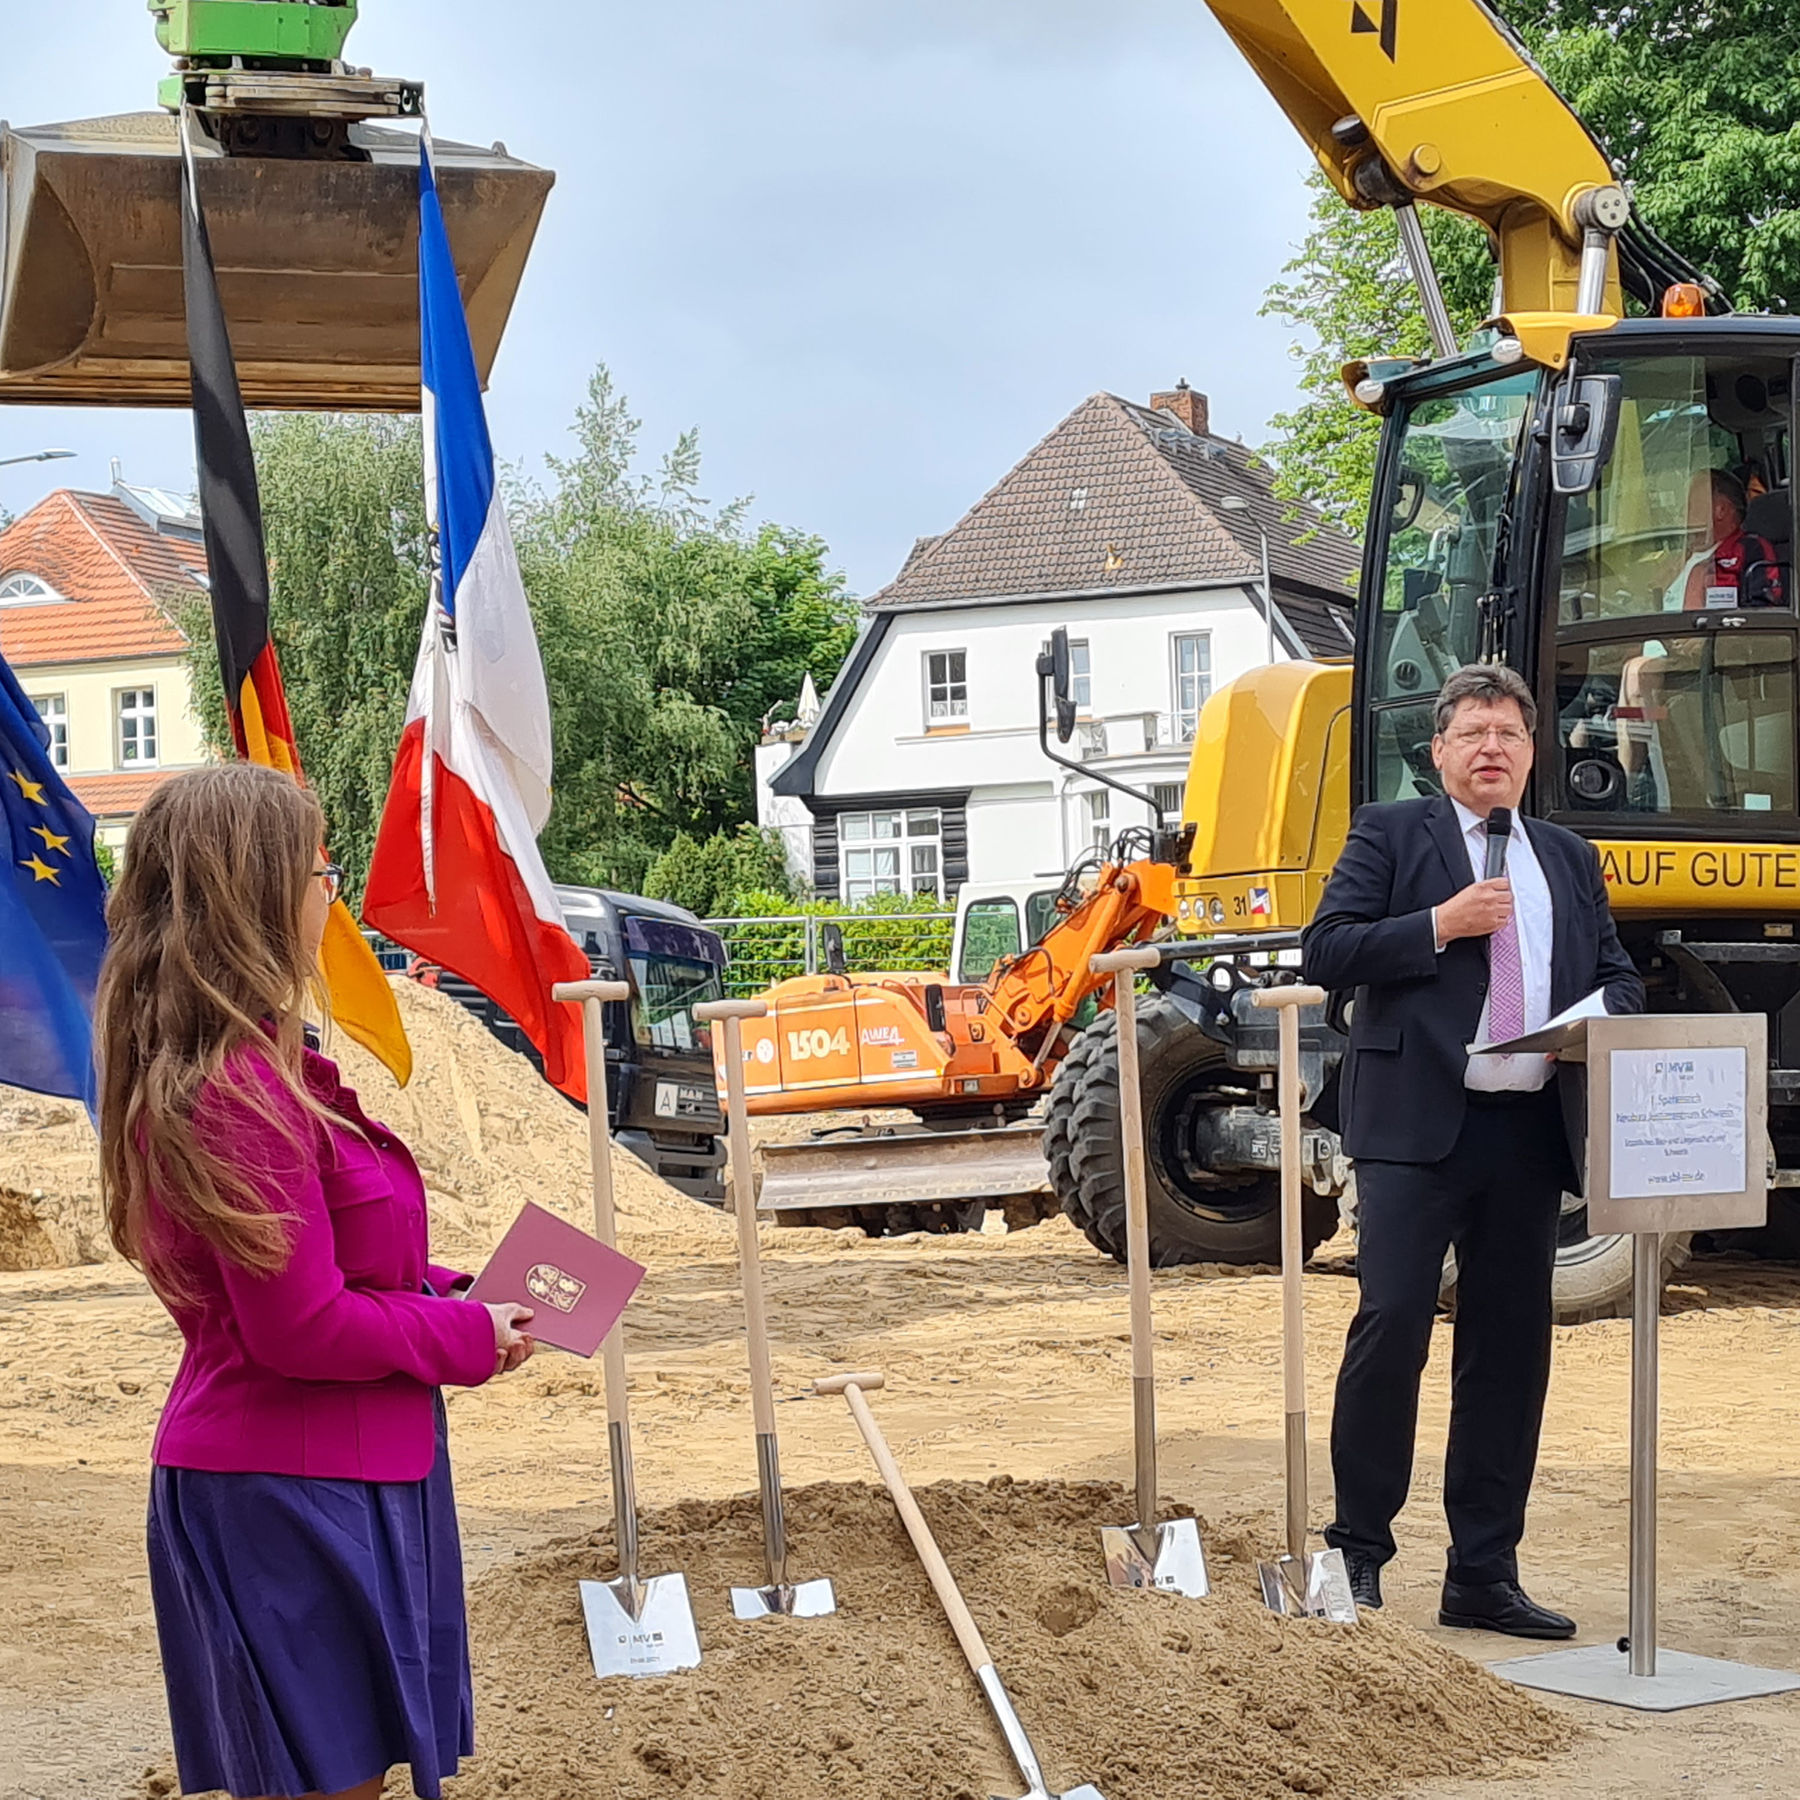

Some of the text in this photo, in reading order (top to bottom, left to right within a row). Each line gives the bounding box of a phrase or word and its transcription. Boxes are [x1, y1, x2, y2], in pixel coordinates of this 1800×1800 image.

[1601, 850, 1797, 888] AUF GUTE
[1233, 896, 1247, 916] 31
[787, 1025, 851, 1061] 1504
